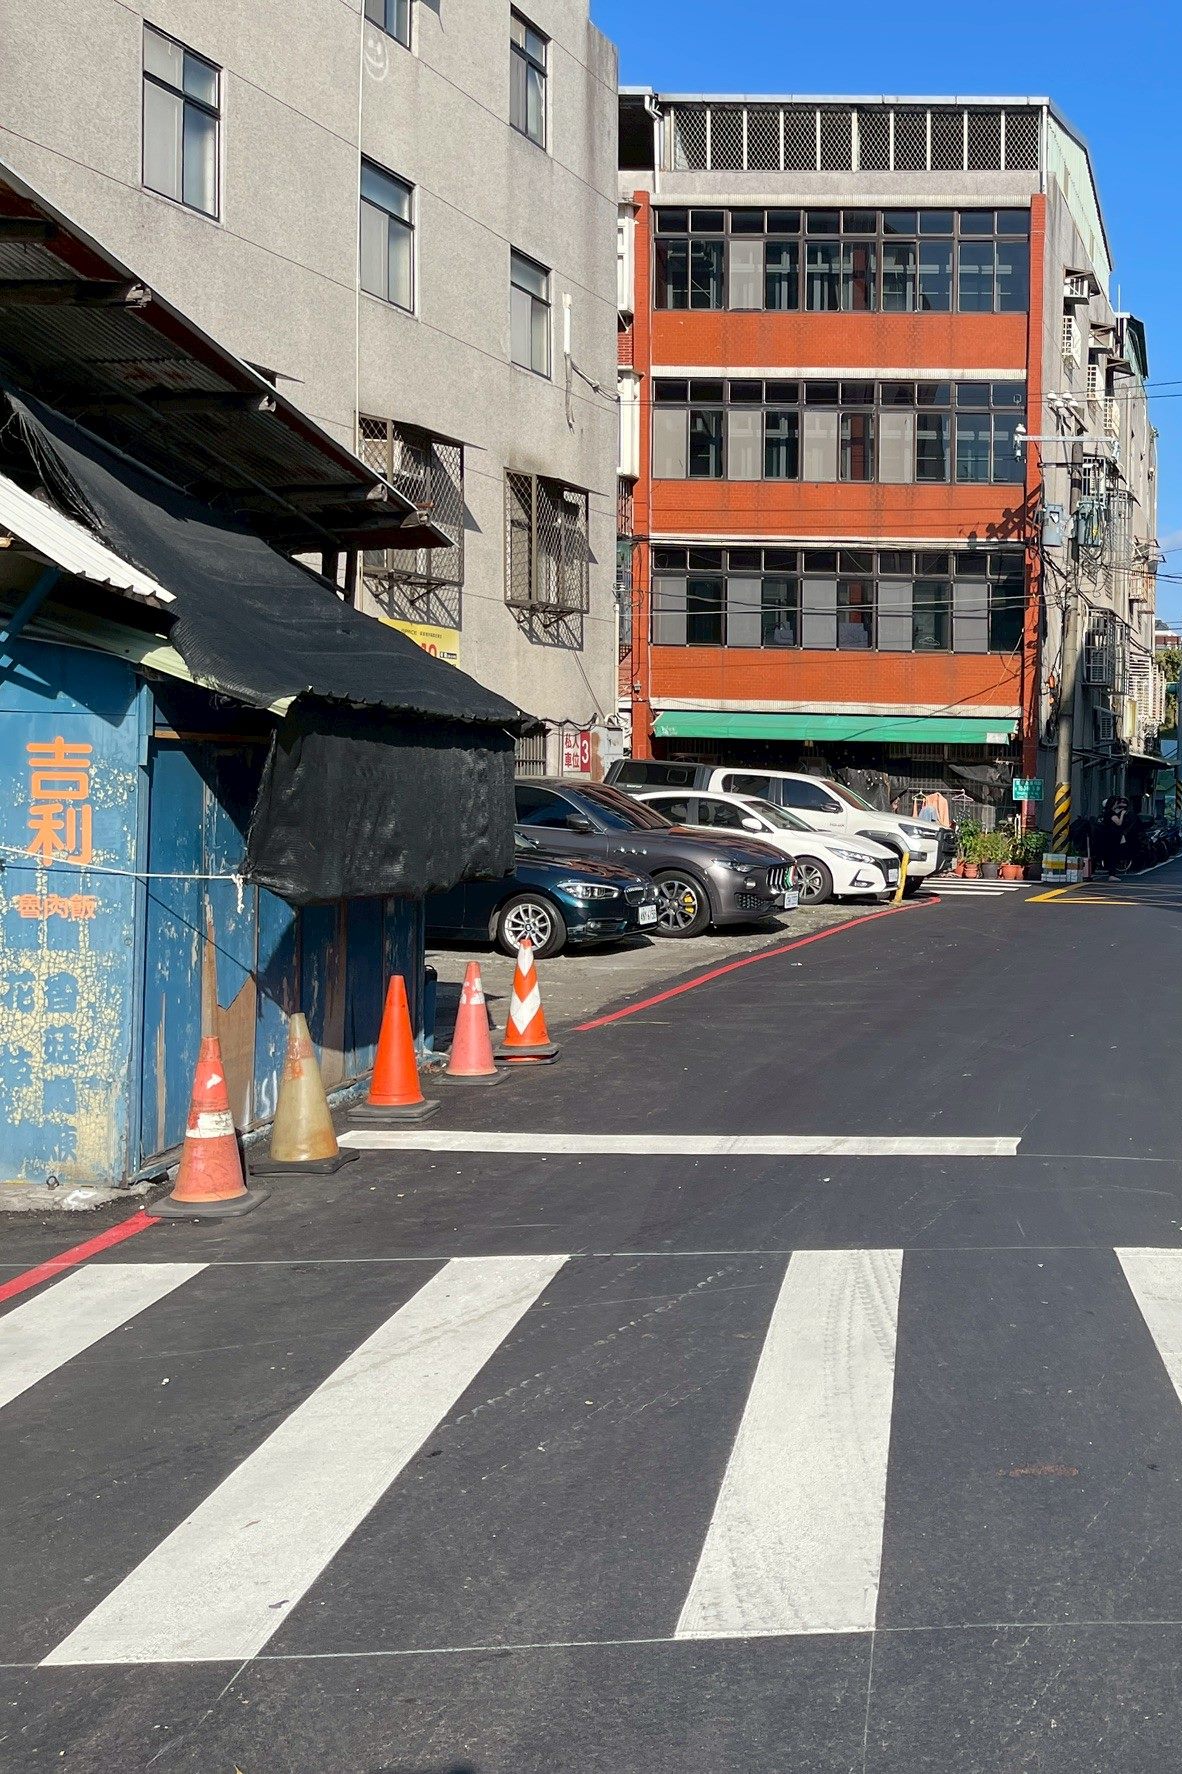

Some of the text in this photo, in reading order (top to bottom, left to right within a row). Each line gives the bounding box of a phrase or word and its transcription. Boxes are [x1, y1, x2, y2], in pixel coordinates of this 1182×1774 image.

[564, 752, 580, 768] 車位
[582, 739, 590, 764] 3
[26, 735, 93, 867] 吉利
